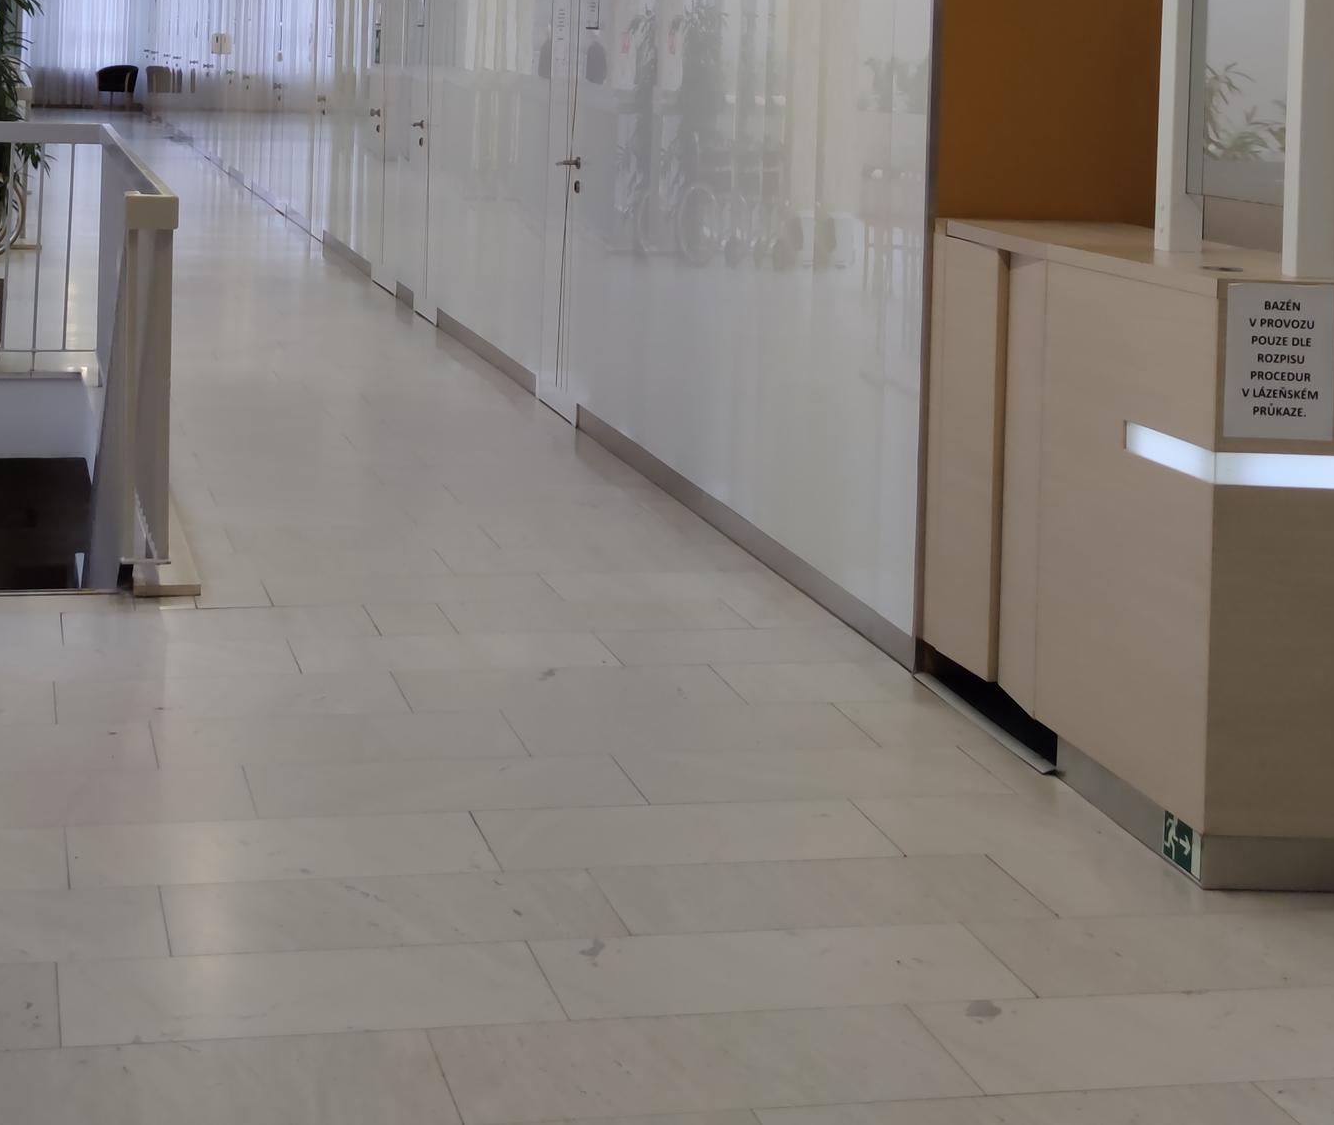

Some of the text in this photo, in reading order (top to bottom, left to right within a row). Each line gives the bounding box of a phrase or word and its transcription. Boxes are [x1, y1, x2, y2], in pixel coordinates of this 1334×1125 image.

[1264, 299, 1301, 311] BAZÉN
[1249, 318, 1315, 330] V PROVOZU
[1251, 335, 1312, 347] POUZE DLE
[1257, 353, 1305, 364] ROZPISU
[1250, 371, 1311, 382] PROCEDUR
[1242, 386, 1319, 400] V LÁZEŇSKÉM
[1252, 403, 1307, 417] PRŮKAZE.
